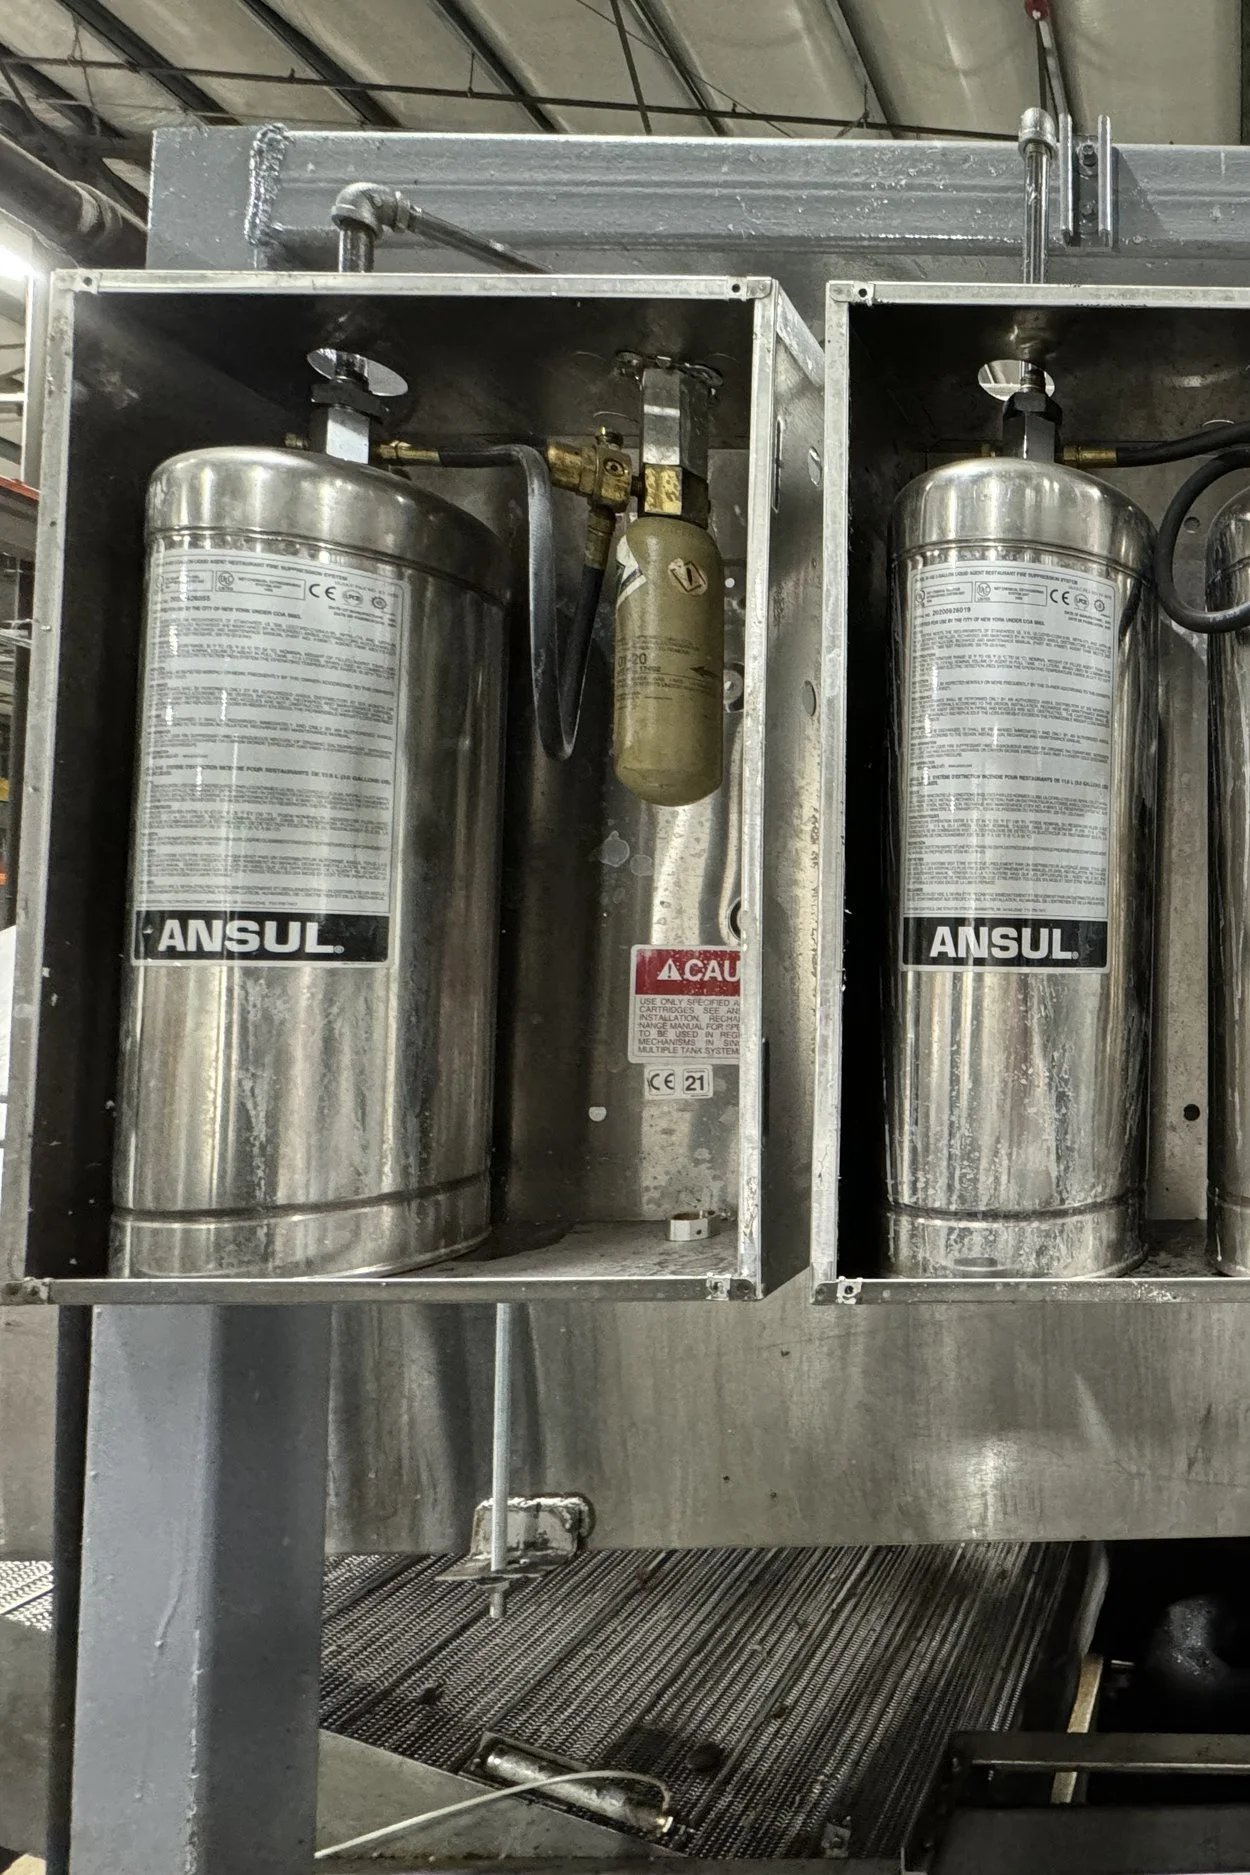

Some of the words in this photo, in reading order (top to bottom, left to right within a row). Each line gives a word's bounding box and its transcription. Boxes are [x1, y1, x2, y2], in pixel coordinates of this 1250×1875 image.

[1050, 589, 1070, 606] CE
[638, 1038, 696, 1046] MECHANISMS
[638, 1046, 678, 1054] MULTIPLE
[650, 1073, 675, 1091] CE
[685, 1075, 704, 1091] 21
